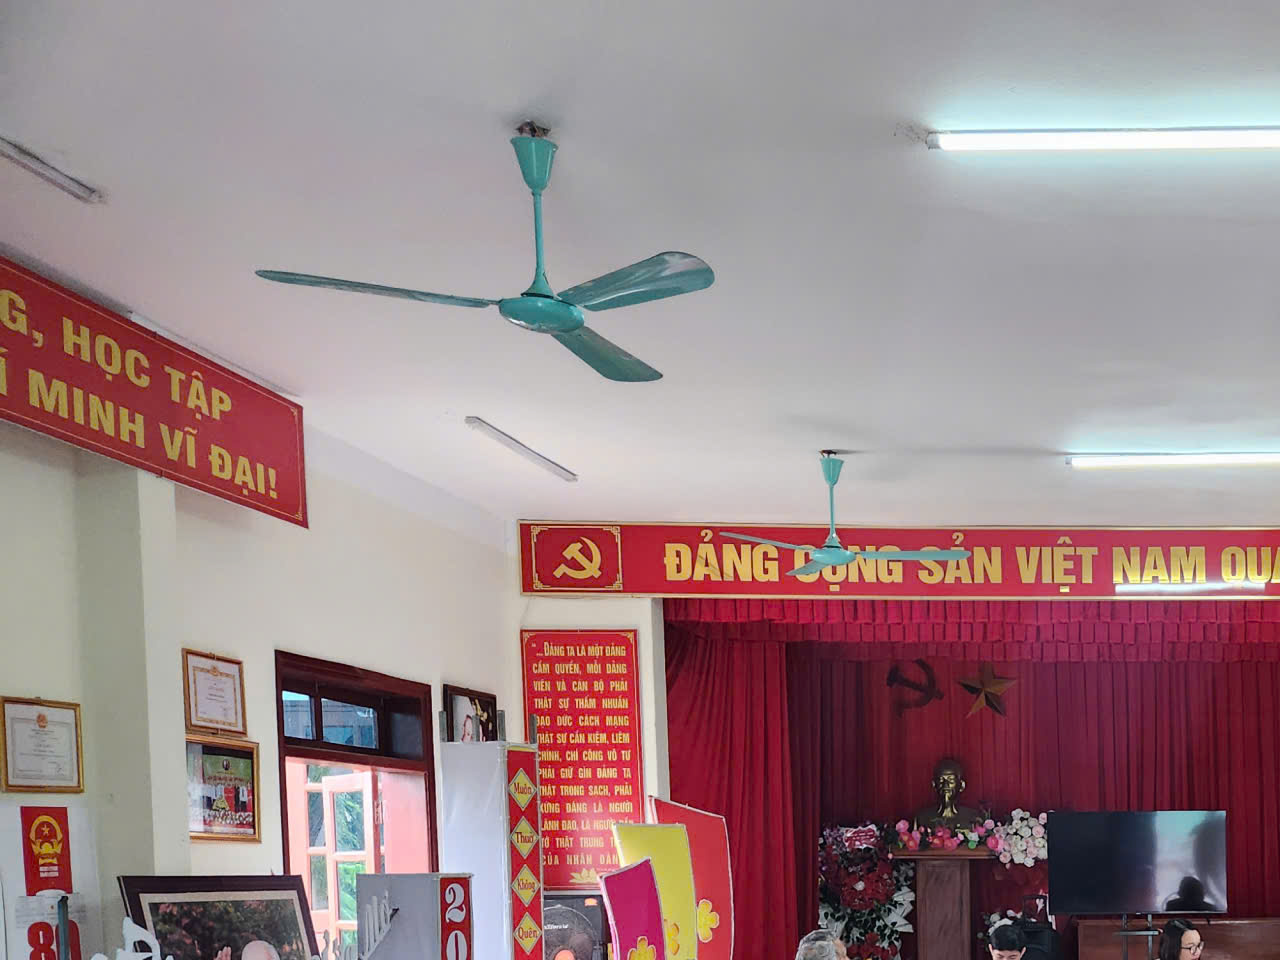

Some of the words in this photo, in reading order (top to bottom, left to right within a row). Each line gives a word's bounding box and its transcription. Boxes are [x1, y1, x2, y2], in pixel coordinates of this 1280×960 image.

[62, 317, 150, 388] HỌC
[163, 365, 232, 421] TẬP
[28, 368, 145, 449] MINH
[159, 422, 198, 469] VĨ
[208, 444, 278, 499] ĐẠI!
[664, 530, 780, 583] ĐẢNG
[917, 532, 1000, 584] SẢN
[1015, 538, 1097, 593] VIỆT
[1113, 546, 1207, 585] NAM
[566, 646, 575, 657] TA
[588, 643, 603, 659] MỘT
[605, 643, 626, 657] ĐẢNG
[606, 660, 627, 674] ĐẢNG
[533, 679, 551, 692] VIÊN
[556, 679, 566, 692] VÀ
[609, 678, 628, 692] PHẢI
[534, 696, 552, 711] THẬT
[579, 714, 600, 727] CÁCH
[582, 749, 604, 762] CÔNG
[622, 767, 632, 779] TA
[560, 785, 585, 796] TRONG
[594, 818, 614, 831] NGƯỜ
